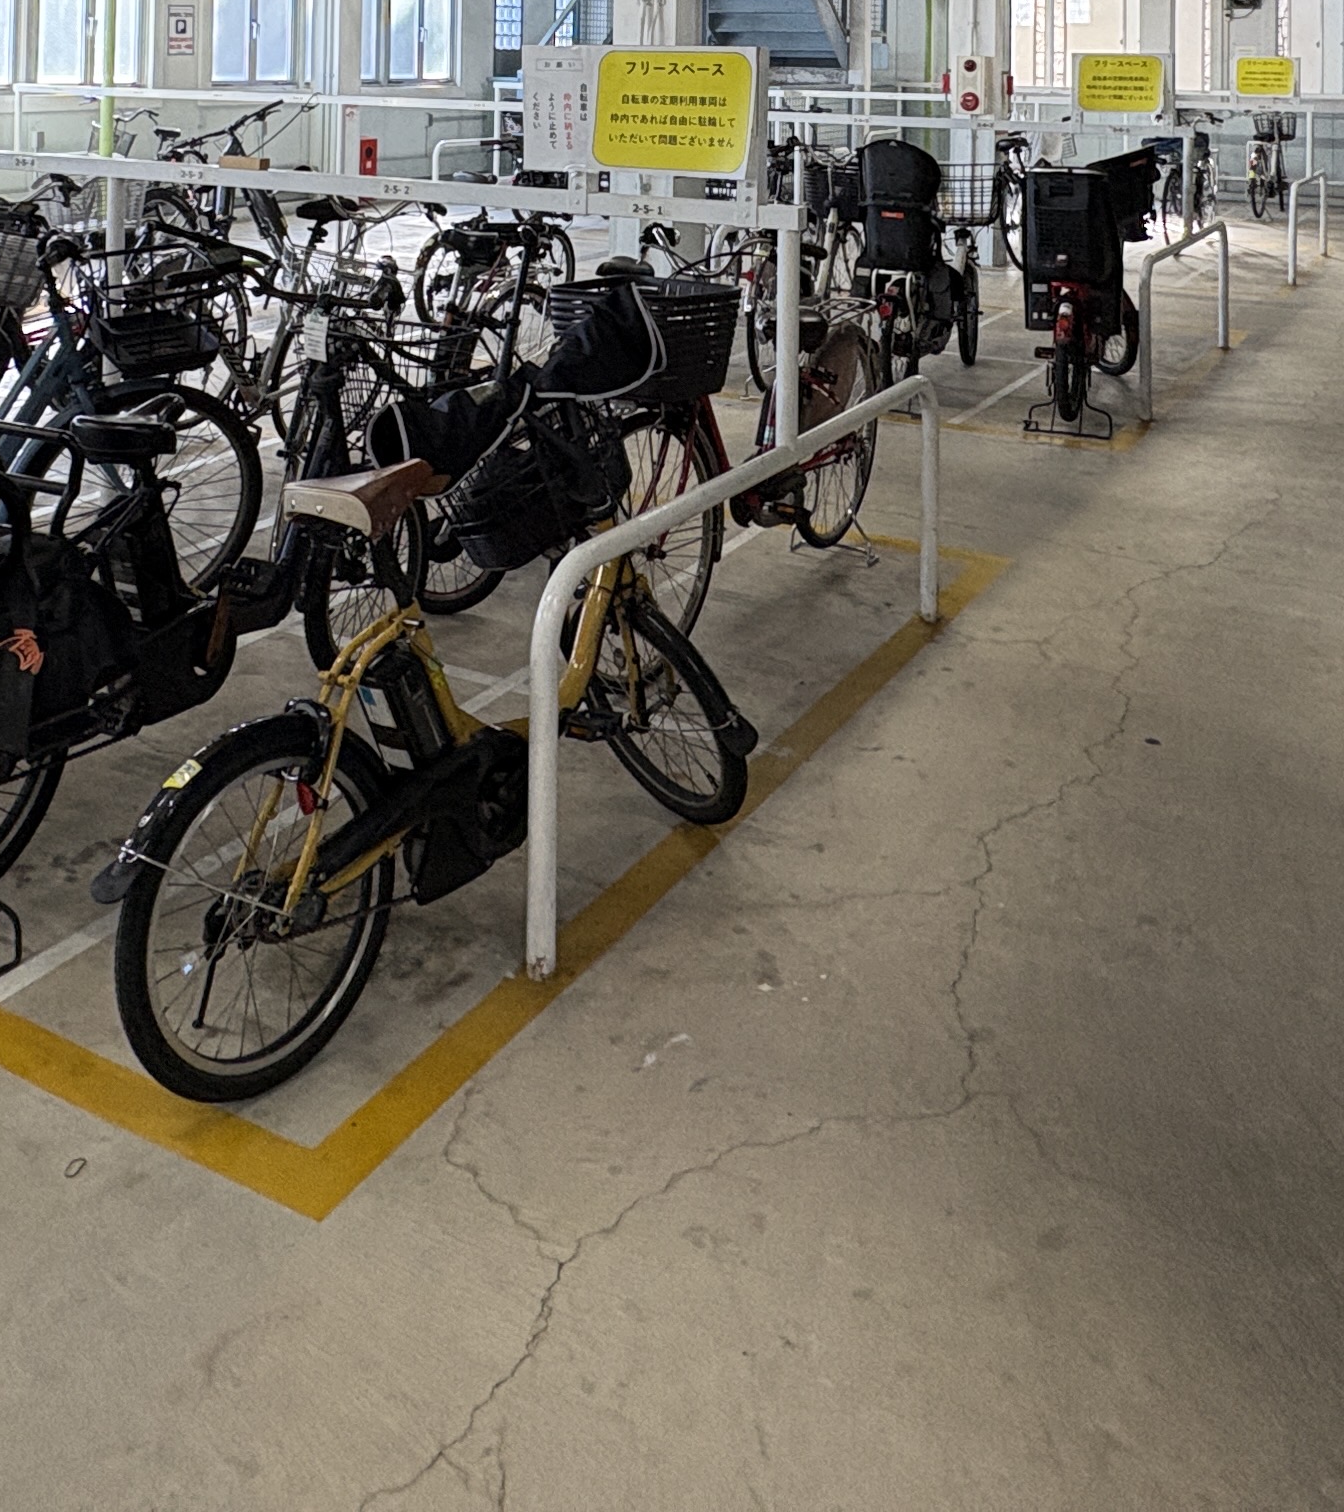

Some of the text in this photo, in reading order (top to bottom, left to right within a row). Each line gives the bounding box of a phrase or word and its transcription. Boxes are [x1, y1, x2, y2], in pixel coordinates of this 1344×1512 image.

[625, 61, 725, 76] フリースペース
[579, 82, 588, 121] 自転車は
[622, 94, 727, 107] 自転車の定期利用車両は
[532, 91, 541, 129] ください
[548, 92, 558, 149] ように止めて
[610, 113, 736, 128] 枠内であれば自由に駐輪して
[609, 133, 734, 148] いただいて問題ございません
